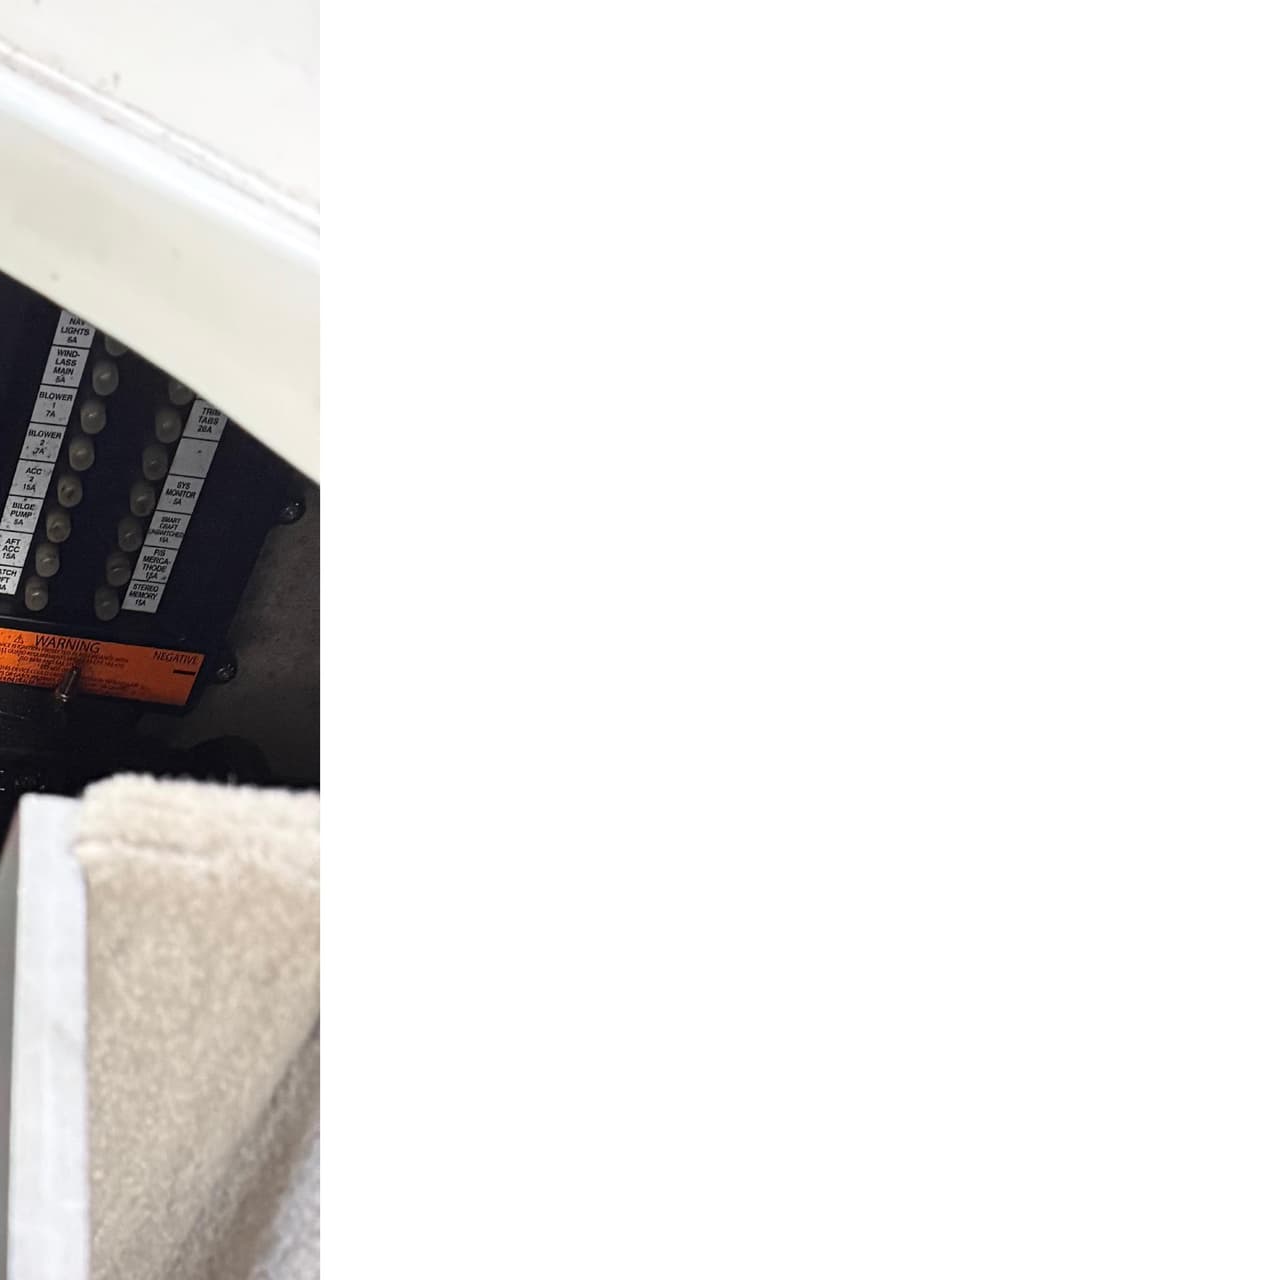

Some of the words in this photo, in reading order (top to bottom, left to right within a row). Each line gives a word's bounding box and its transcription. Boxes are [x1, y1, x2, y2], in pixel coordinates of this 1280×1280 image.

[61, 327, 90, 336] LIGHTS
[57, 349, 80, 358] WIND-
[55, 358, 77, 366] LASS
[53, 367, 74, 375] MAIN
[39, 392, 73, 401] BLOWER
[199, 416, 219, 425] TABS
[28, 429, 62, 439] BLOWER
[25, 467, 42, 475] ACC
[23, 483, 36, 491] 15A
[166, 489, 196, 498] MONITOR
[12, 502, 35, 511] BILGE
[10, 510, 32, 518] PUMP
[2, 545, 20, 553] ACC
[143, 564, 167, 572] THODE
[133, 584, 159, 592] STEREO
[129, 591, 157, 600] MEMORY
[35, 635, 101, 653] WARNING
[153, 651, 198, 664] NEGATIVE
